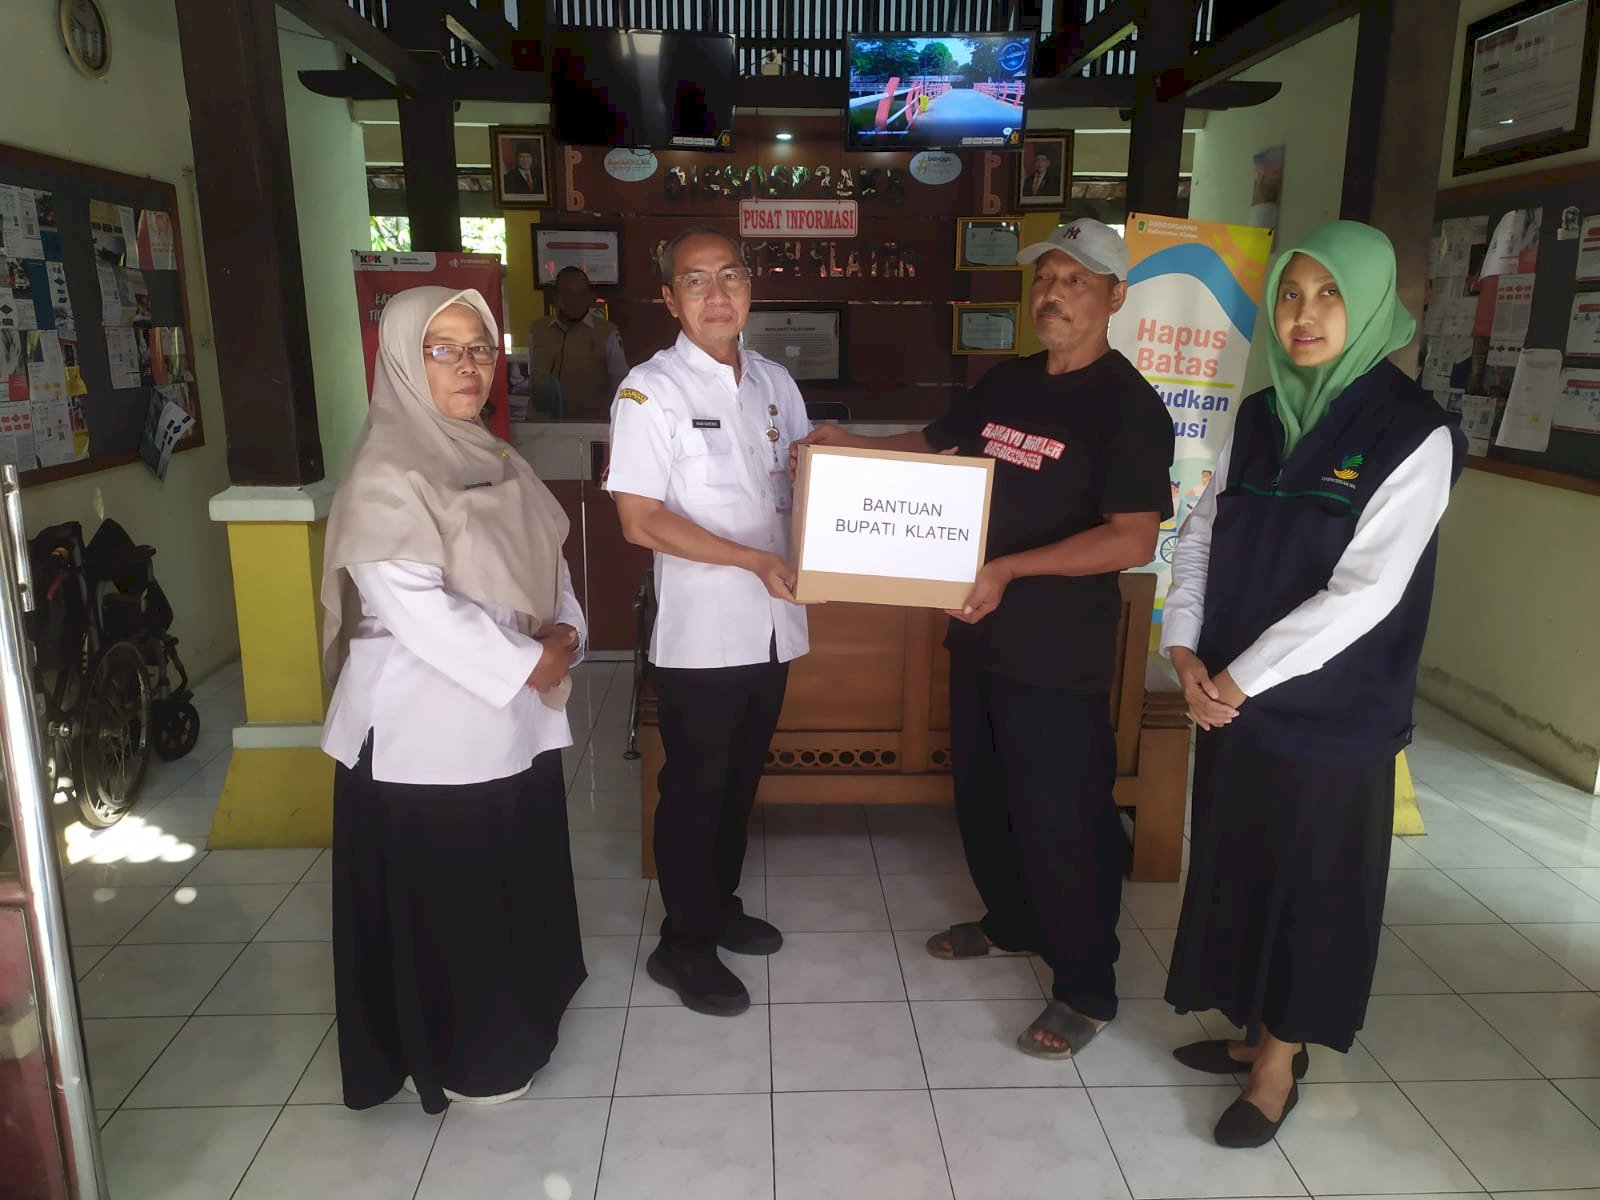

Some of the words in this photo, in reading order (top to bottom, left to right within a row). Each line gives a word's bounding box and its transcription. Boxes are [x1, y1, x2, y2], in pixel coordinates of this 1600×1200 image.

[743, 209, 782, 229] PUSAT
[785, 209, 854, 229] INFORMASI
[360, 254, 382, 264] KPK
[1137, 318, 1228, 352] Hapus
[1136, 347, 1218, 378] Batas
[863, 497, 943, 517] BANTUAN
[835, 518, 896, 537] BUPATI
[905, 524, 970, 542] KLATEN
